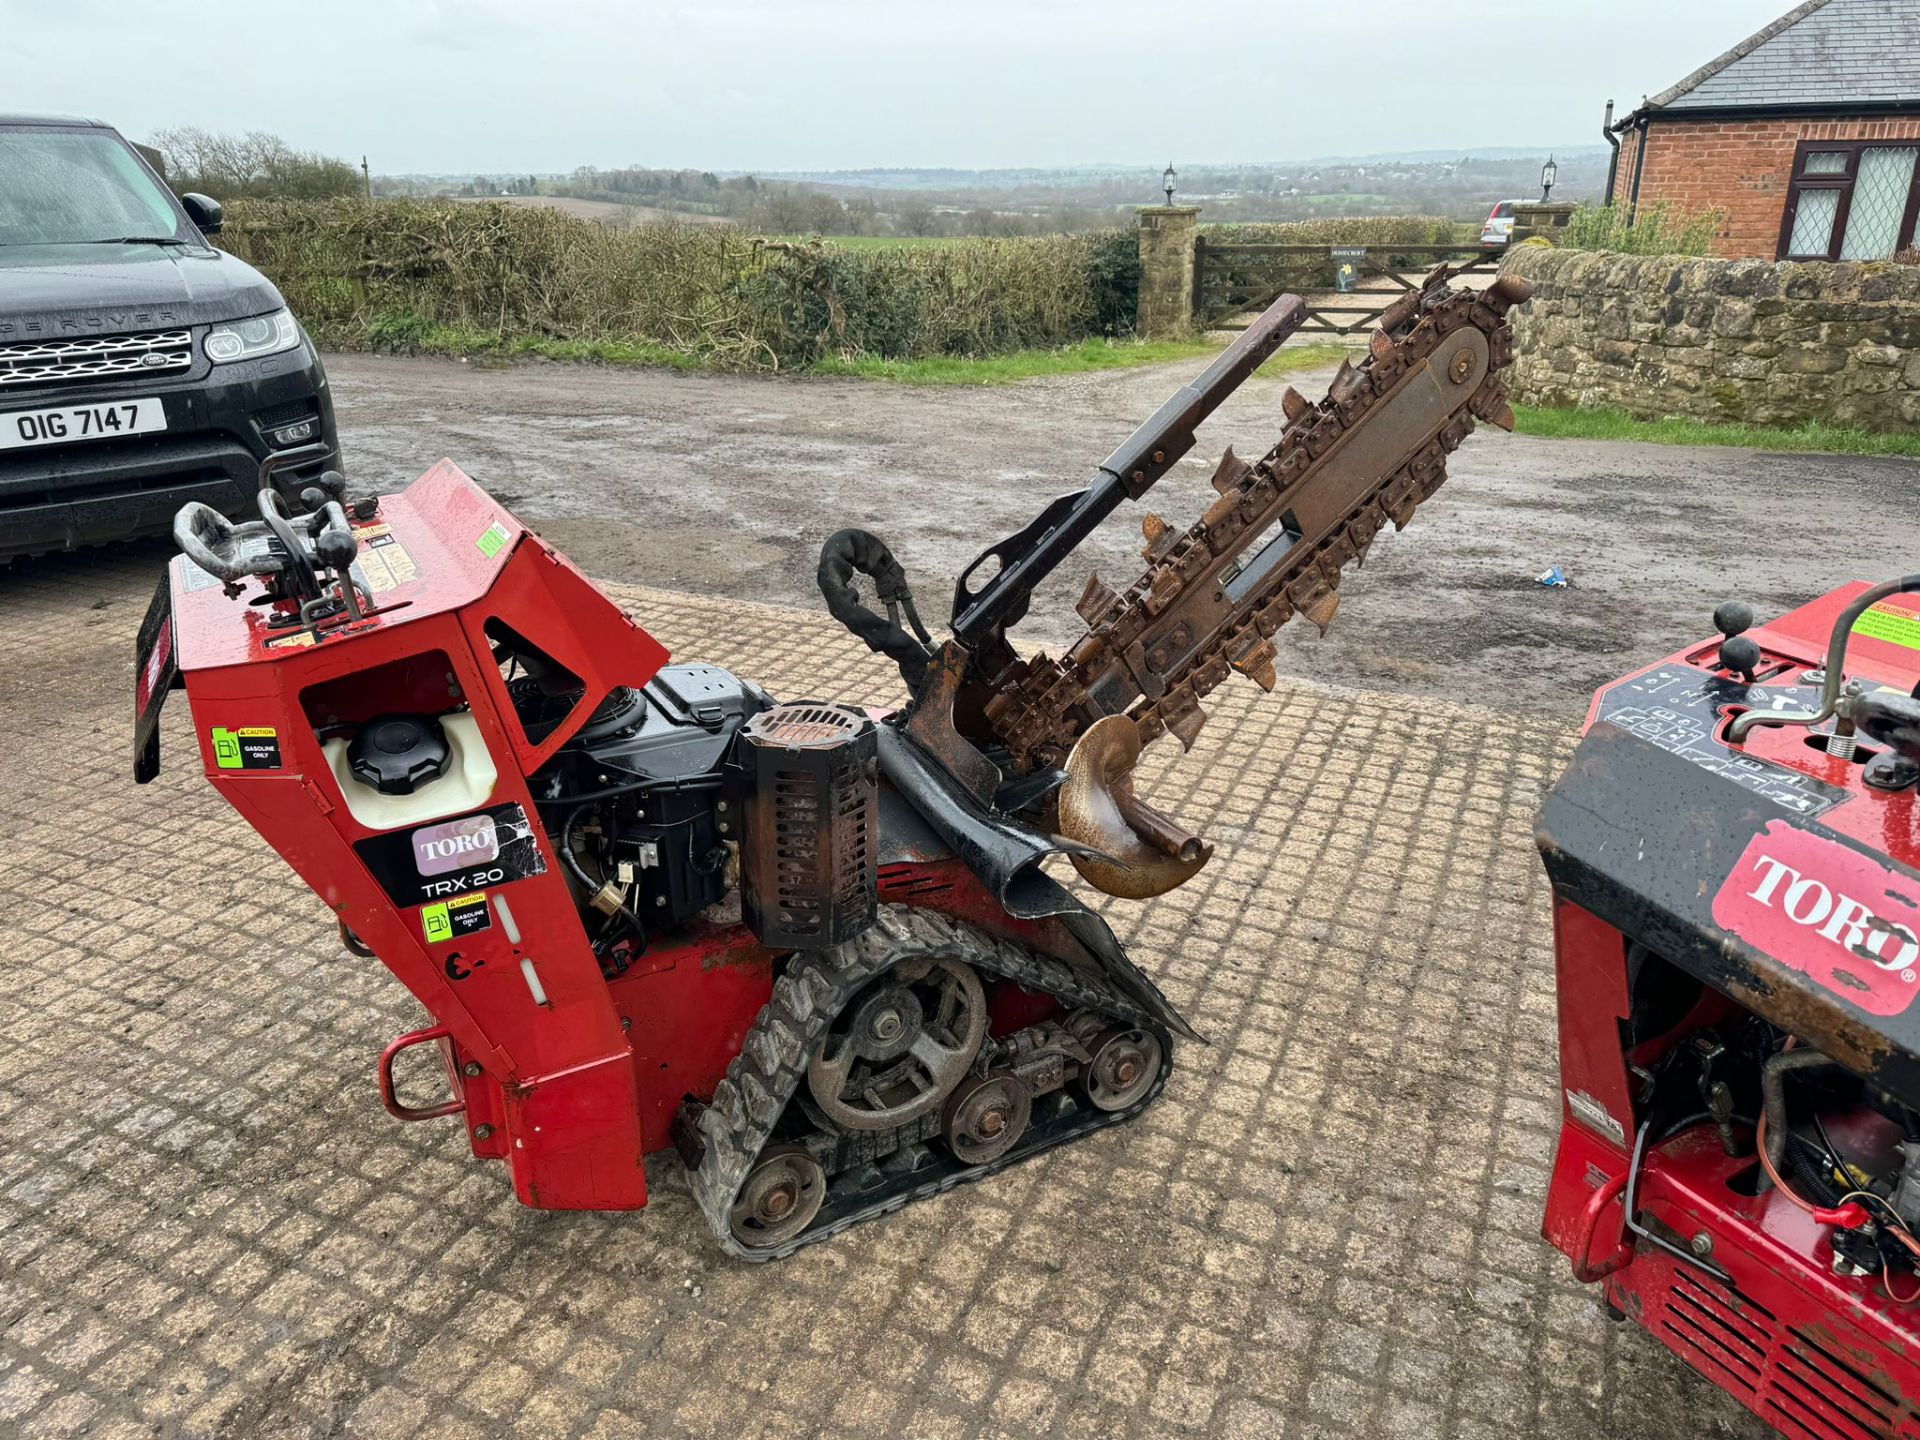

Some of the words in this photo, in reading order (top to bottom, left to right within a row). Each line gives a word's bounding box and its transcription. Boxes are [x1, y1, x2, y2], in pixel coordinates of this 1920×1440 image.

[62, 312, 177, 329] ROVER
[17, 413, 67, 441] OIG
[74, 405, 139, 435] 7147
[1877, 604, 1911, 617] CAUTION
[420, 829, 491, 861] TORO
[455, 894, 484, 906] CAUTION
[454, 909, 485, 922] GASOLINE
[1746, 854, 1920, 971] TORO
[462, 917, 479, 926] ONLY
